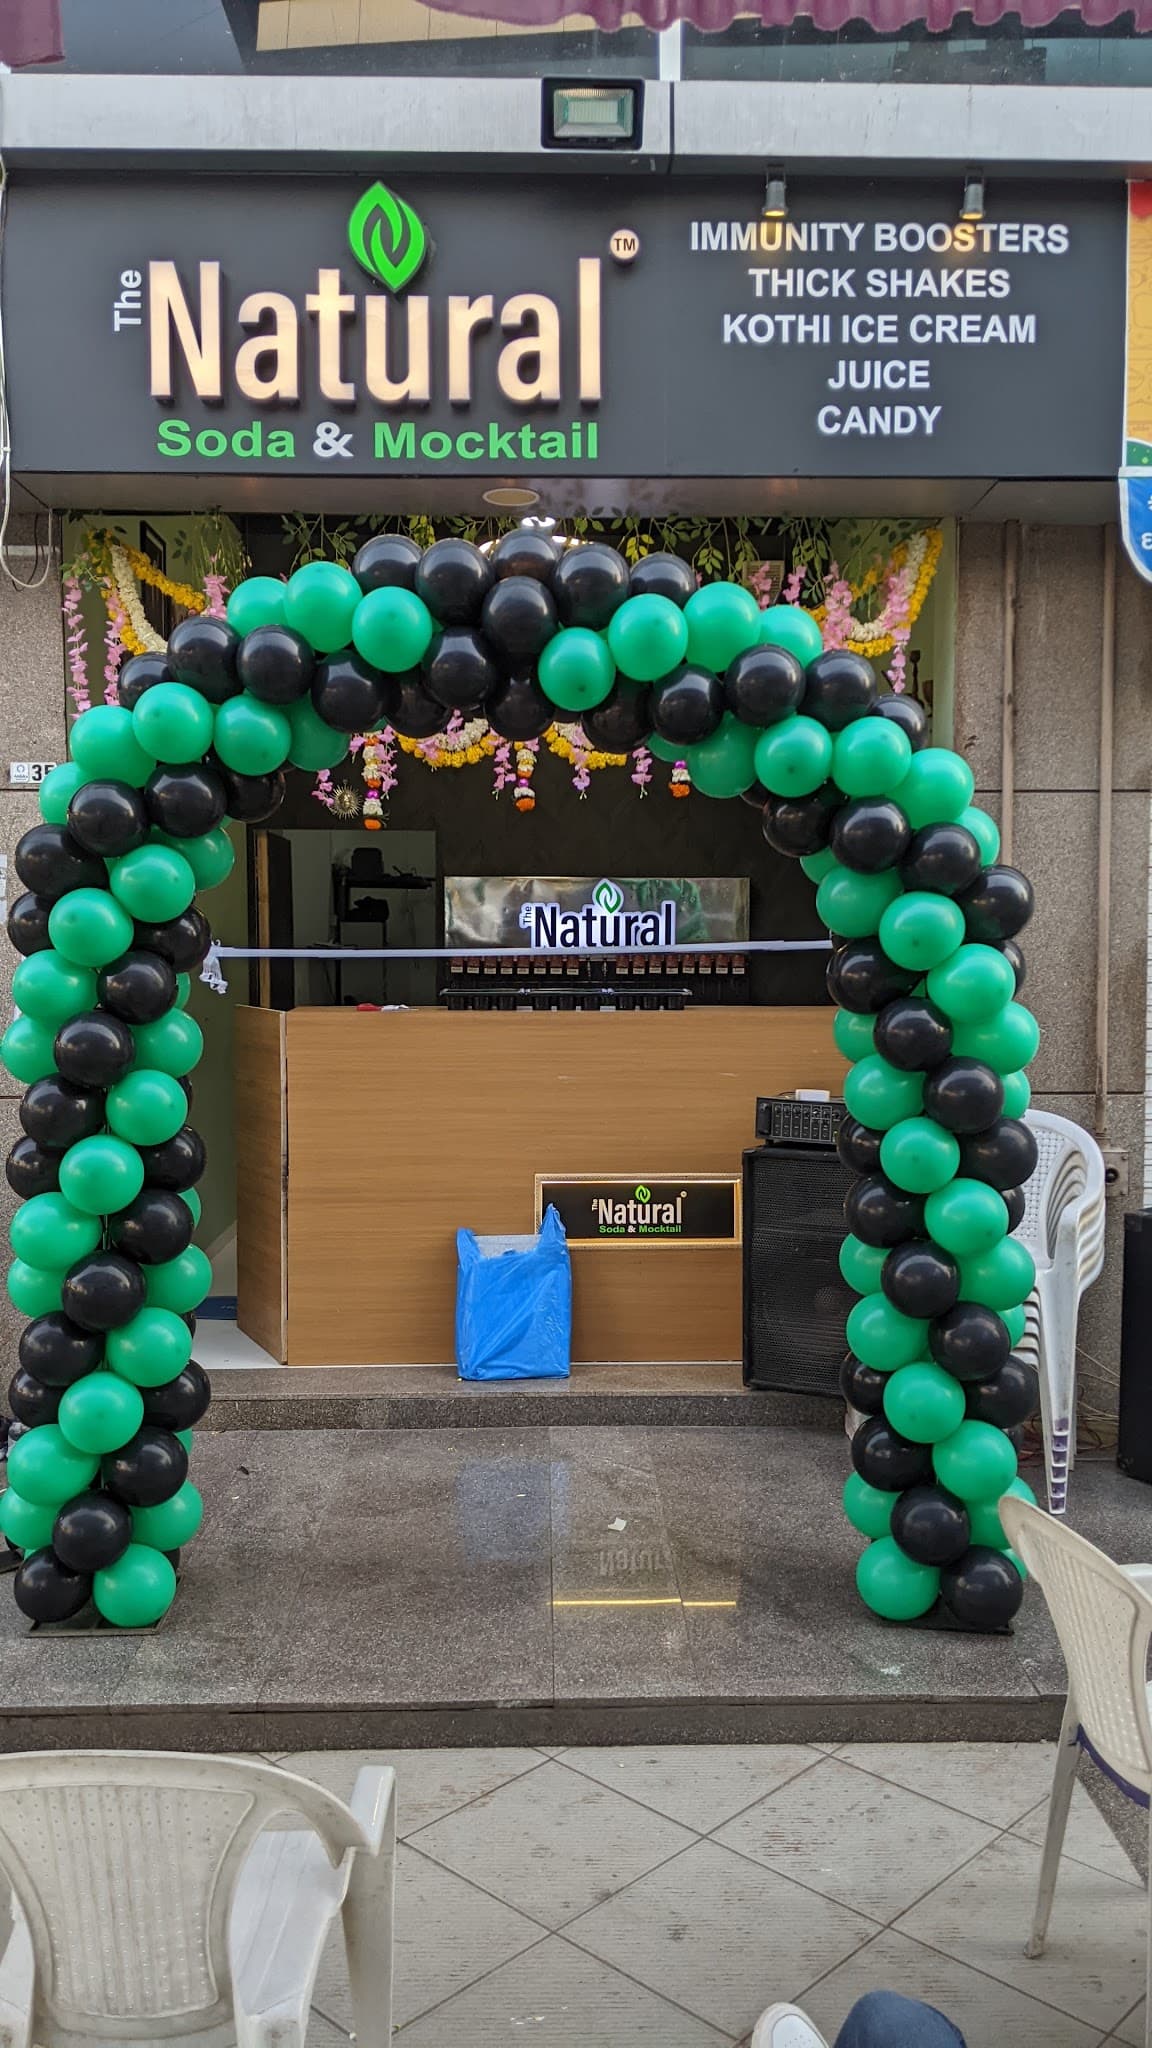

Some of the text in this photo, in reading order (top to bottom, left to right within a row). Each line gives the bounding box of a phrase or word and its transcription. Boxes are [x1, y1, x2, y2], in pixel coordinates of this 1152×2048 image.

[690, 221, 1070, 254] IMMUNITY BOOSTERS
[748, 268, 1011, 298] THICK SHAKES
[113, 237, 636, 401] The Natural TM
[722, 314, 1037, 344] KOTHI ICE CREAM
[827, 360, 931, 389] JUICE
[816, 405, 942, 434] CANDY
[156, 419, 599, 460] Soda & Mocktail
[523, 903, 672, 948] The Natural
[598, 1197, 682, 1225] Natural
[599, 1225, 682, 1233] Soda & Mocktail
